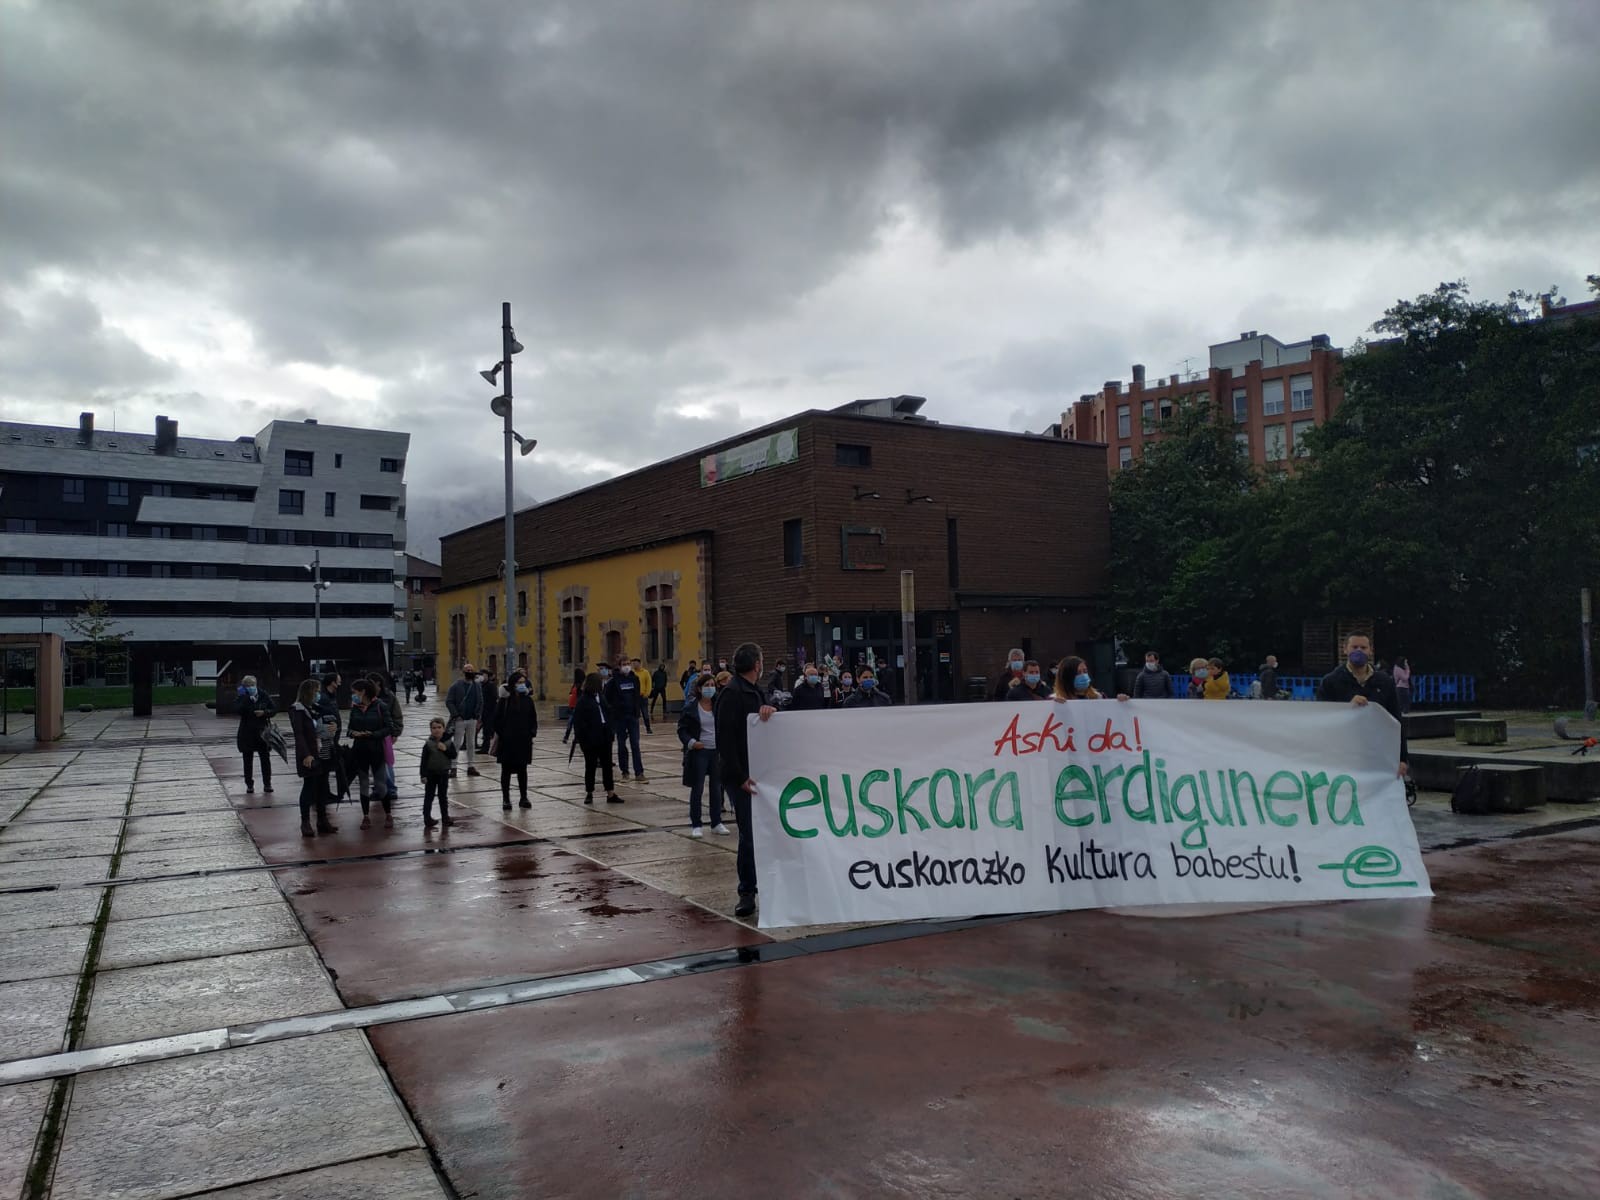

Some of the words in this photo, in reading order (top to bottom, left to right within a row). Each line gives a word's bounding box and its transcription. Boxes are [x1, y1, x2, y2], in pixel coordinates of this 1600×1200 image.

[1088, 717, 1142, 753] da!
[779, 767, 1024, 838] euskara
[1055, 750, 1364, 849] erdigunera
[848, 851, 1026, 890] euskarazko
[1171, 842, 1302, 883] babestu!
